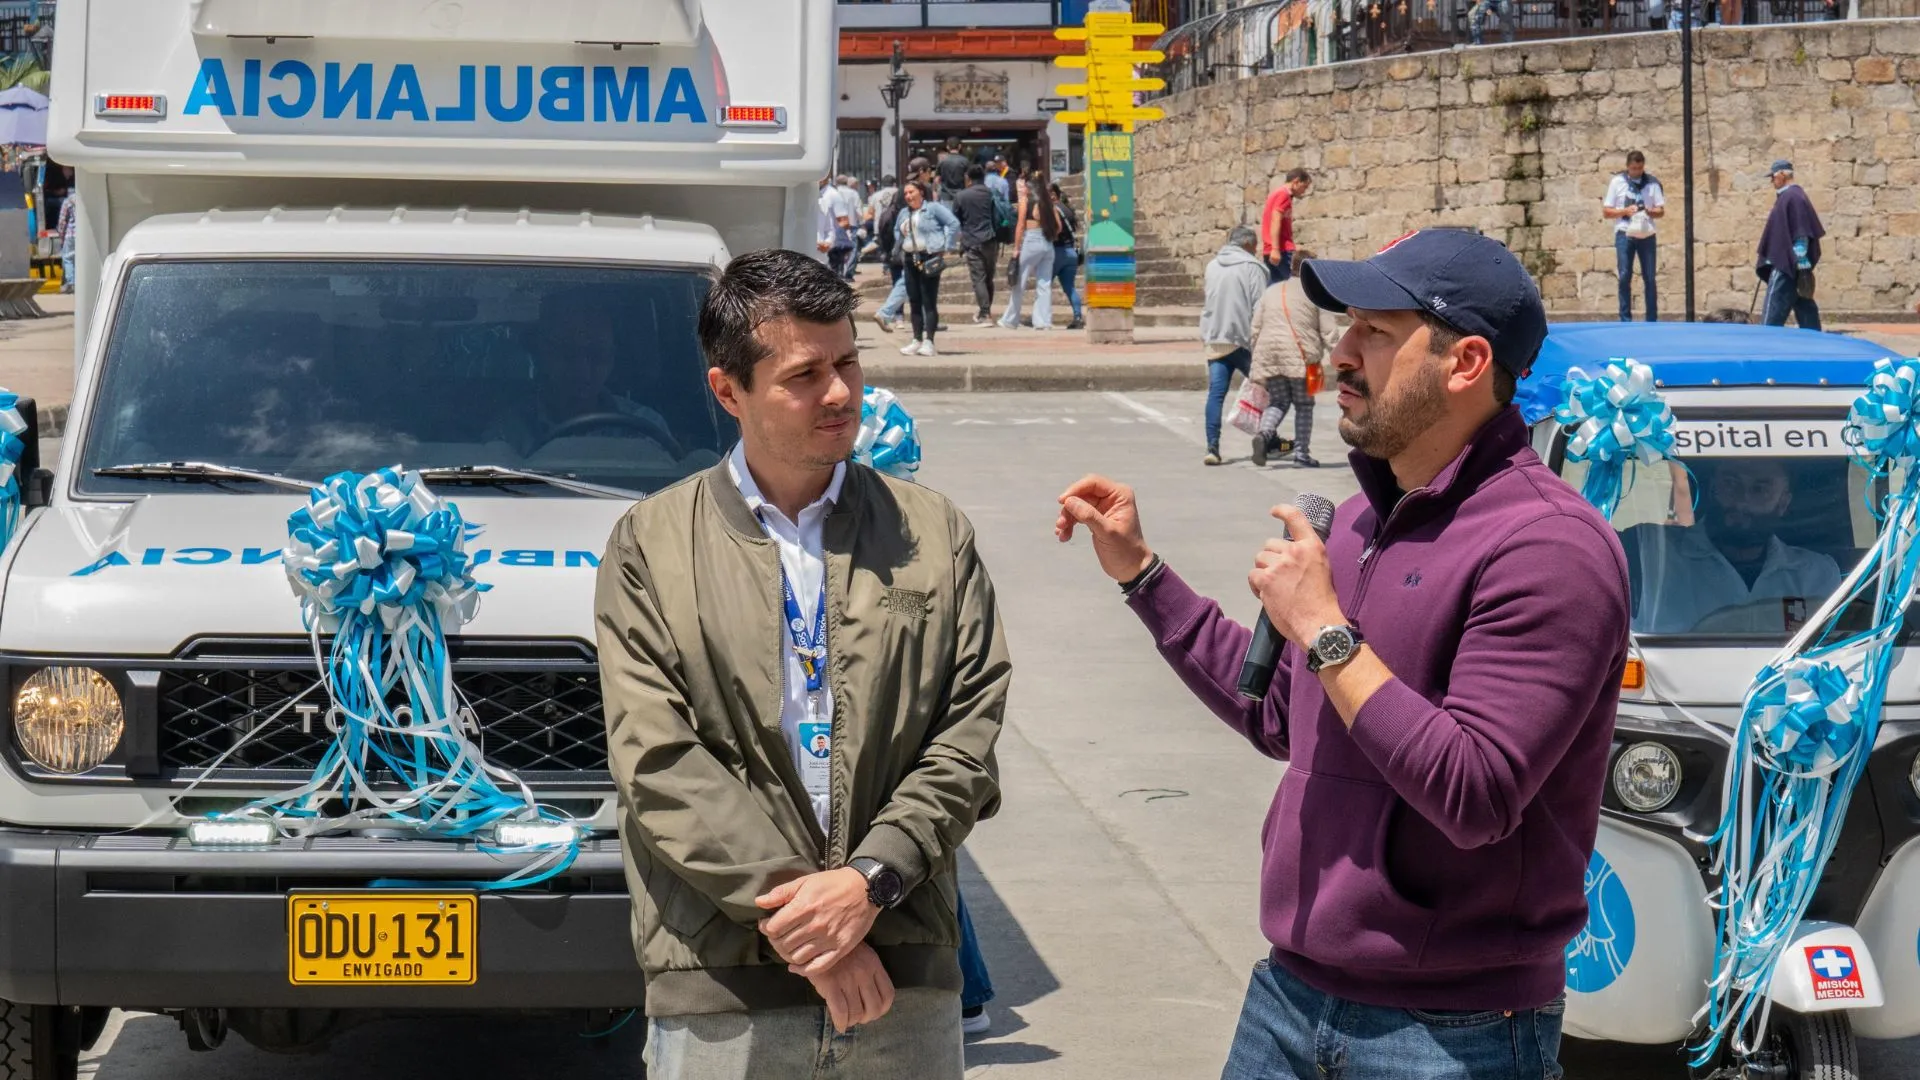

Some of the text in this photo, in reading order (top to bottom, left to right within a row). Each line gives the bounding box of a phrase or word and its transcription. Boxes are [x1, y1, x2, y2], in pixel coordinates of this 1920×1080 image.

[1675, 423, 1772, 453] spital
[1784, 430, 1828, 448] en
[299, 913, 464, 959] ODU 131
[343, 962, 423, 977] ENVIGADO
[1817, 979, 1859, 990] MISIÓN
[1816, 989, 1863, 999] MEDICA
